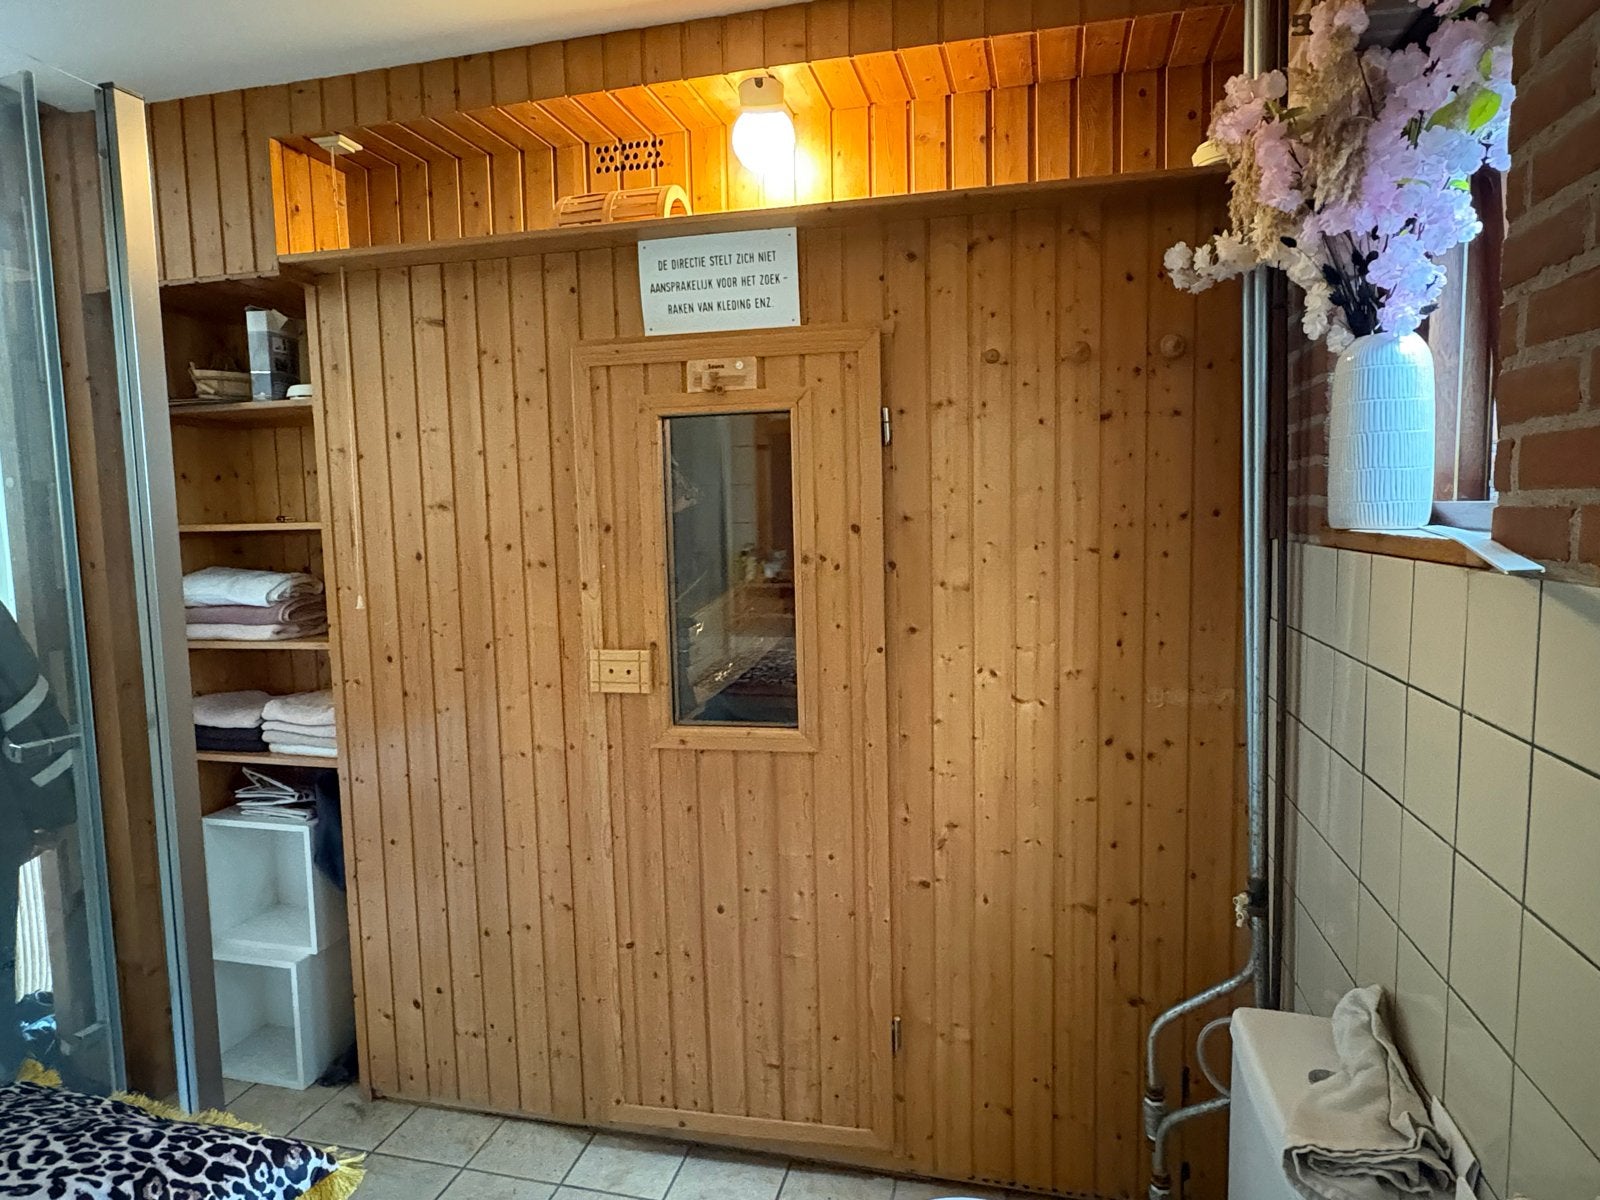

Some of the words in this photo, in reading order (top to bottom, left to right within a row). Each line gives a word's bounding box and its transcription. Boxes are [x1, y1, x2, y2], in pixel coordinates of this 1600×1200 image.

[658, 259, 668, 271] DE
[671, 256, 706, 270] DIRECTIE
[709, 253, 732, 267] STELT
[736, 251, 755, 265] ZICH
[758, 250, 776, 263] NIET
[650, 278, 713, 294] AANSPRAKELIJK
[716, 276, 738, 289] VOOR
[741, 275, 756, 287] HET
[667, 302, 694, 315] RAKEN
[698, 301, 713, 313] VAN
[717, 298, 751, 311] KLEDING
